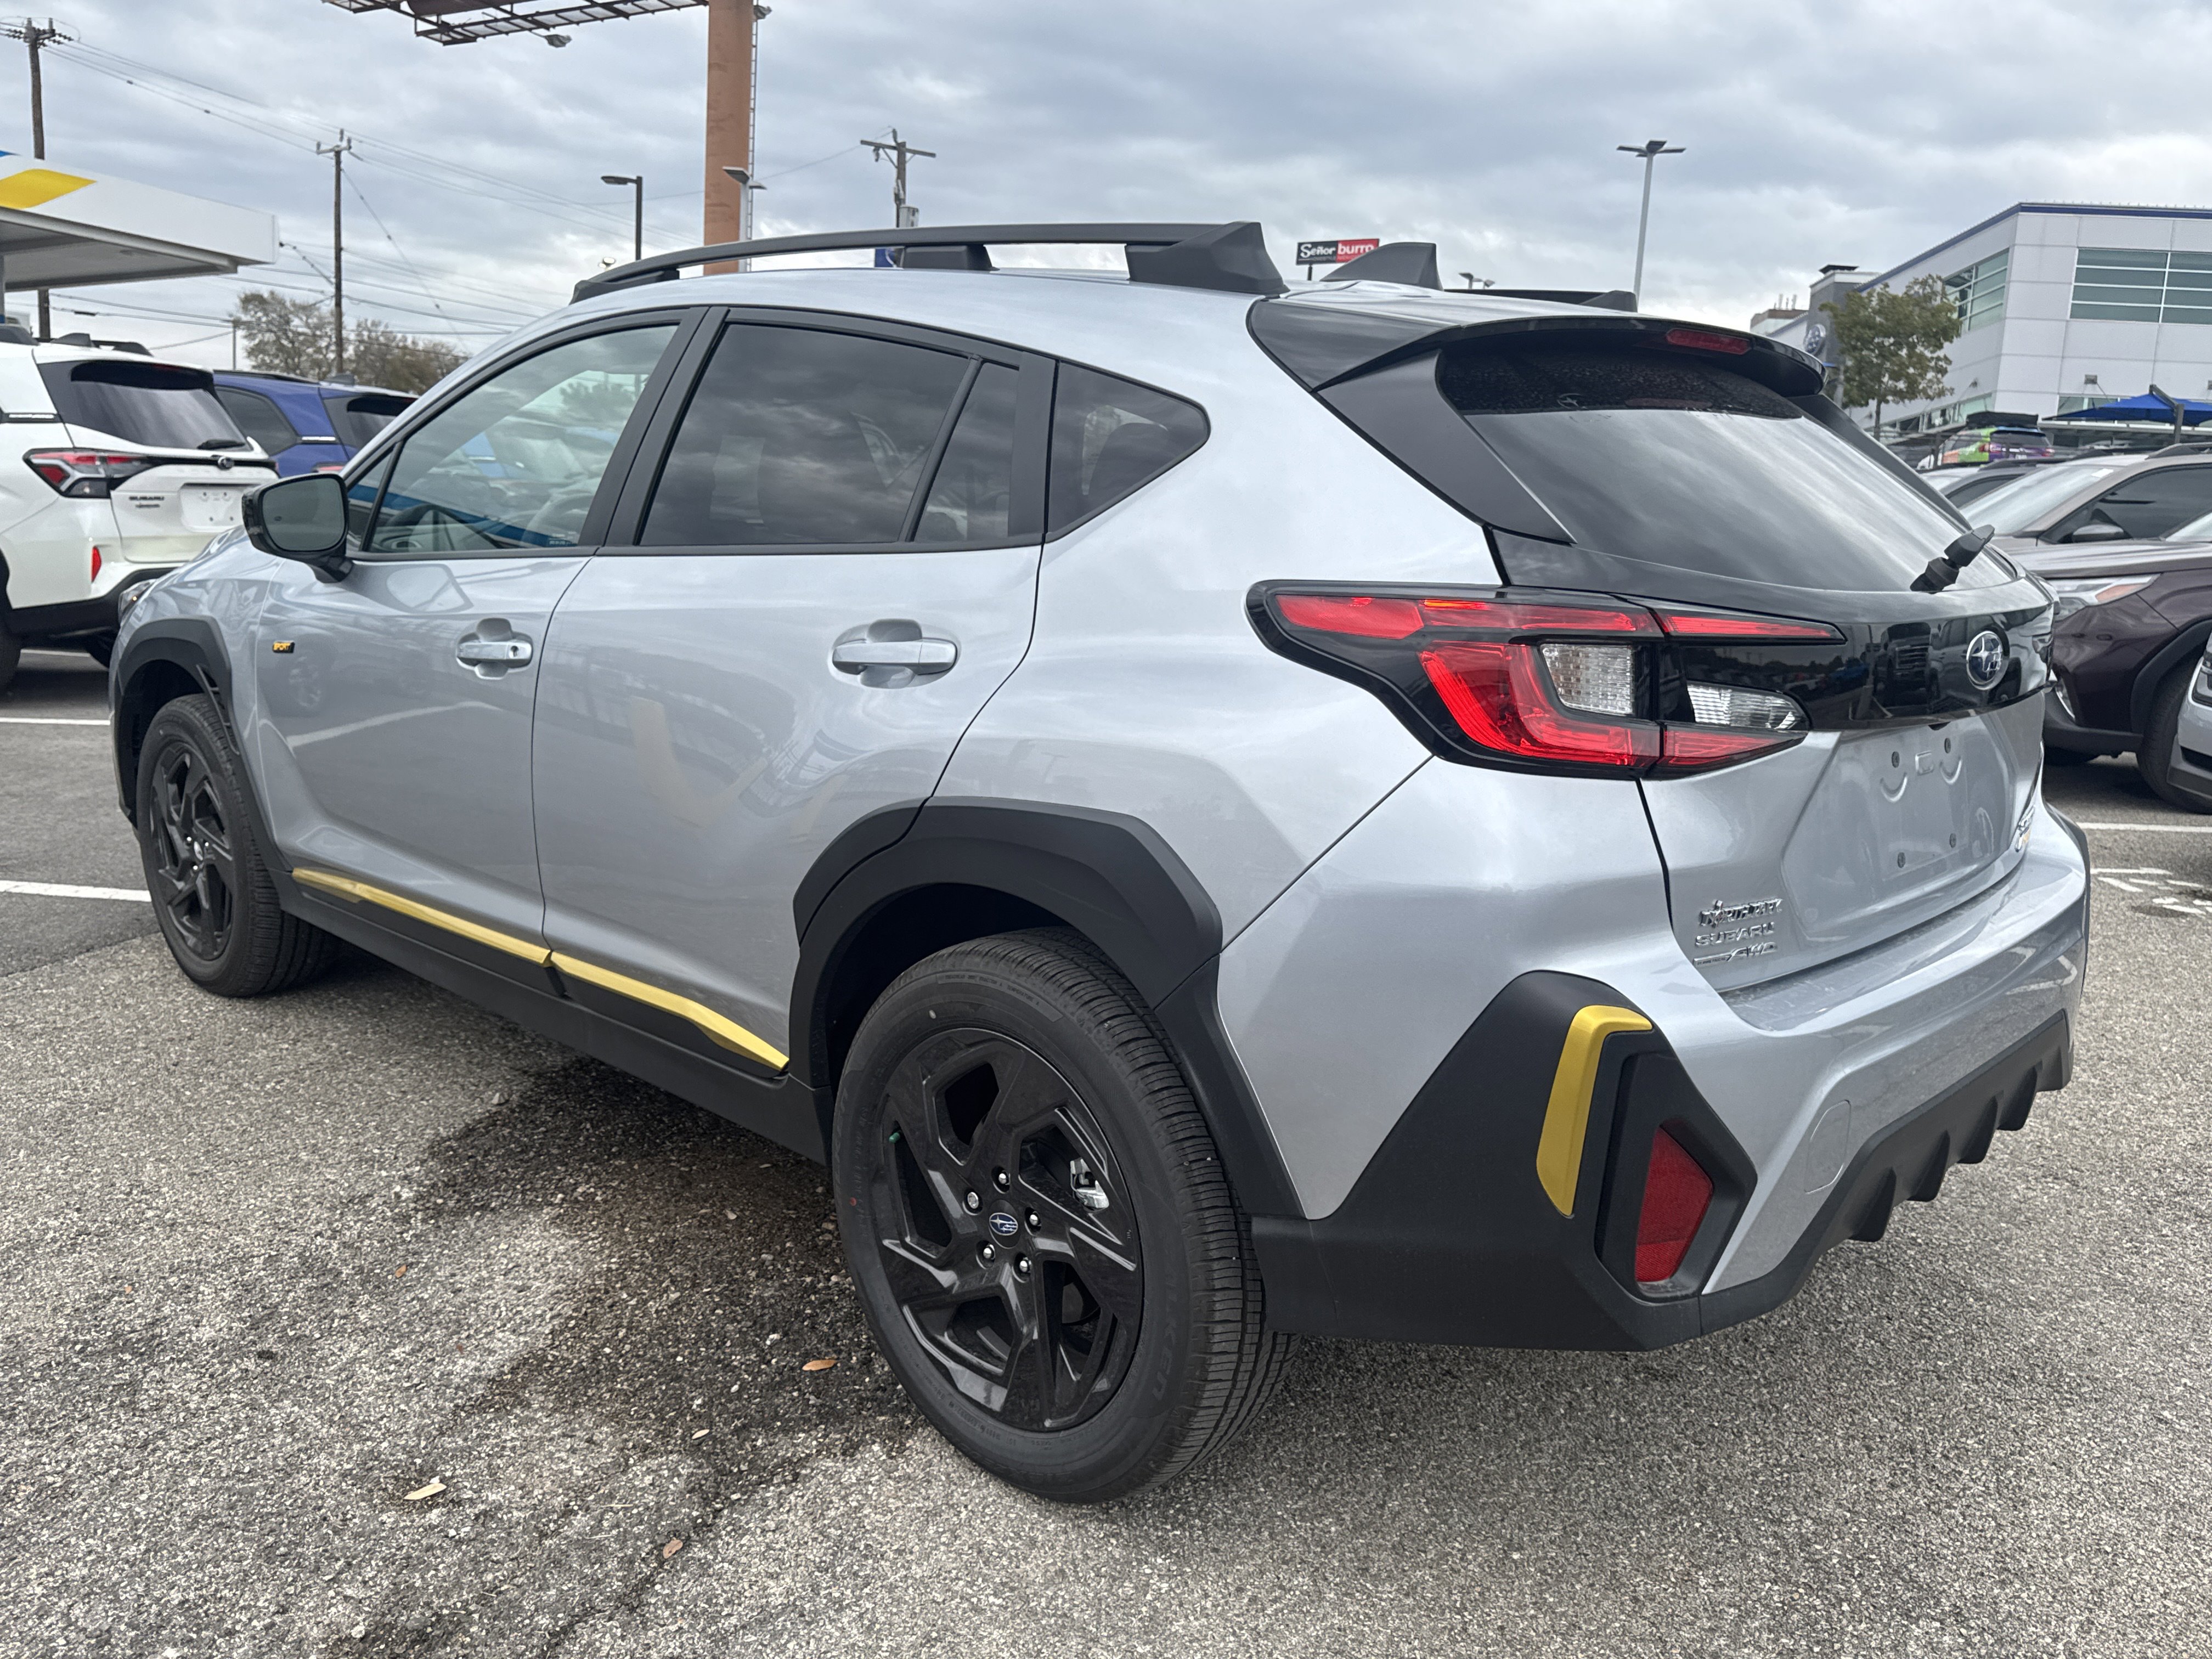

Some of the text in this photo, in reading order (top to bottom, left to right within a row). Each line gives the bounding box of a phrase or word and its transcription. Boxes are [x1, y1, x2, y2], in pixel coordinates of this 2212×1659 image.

[1300, 243, 1374, 258] Señor burro
[1695, 921, 1775, 947] SUBARU
[1726, 941, 1778, 961] AWD
